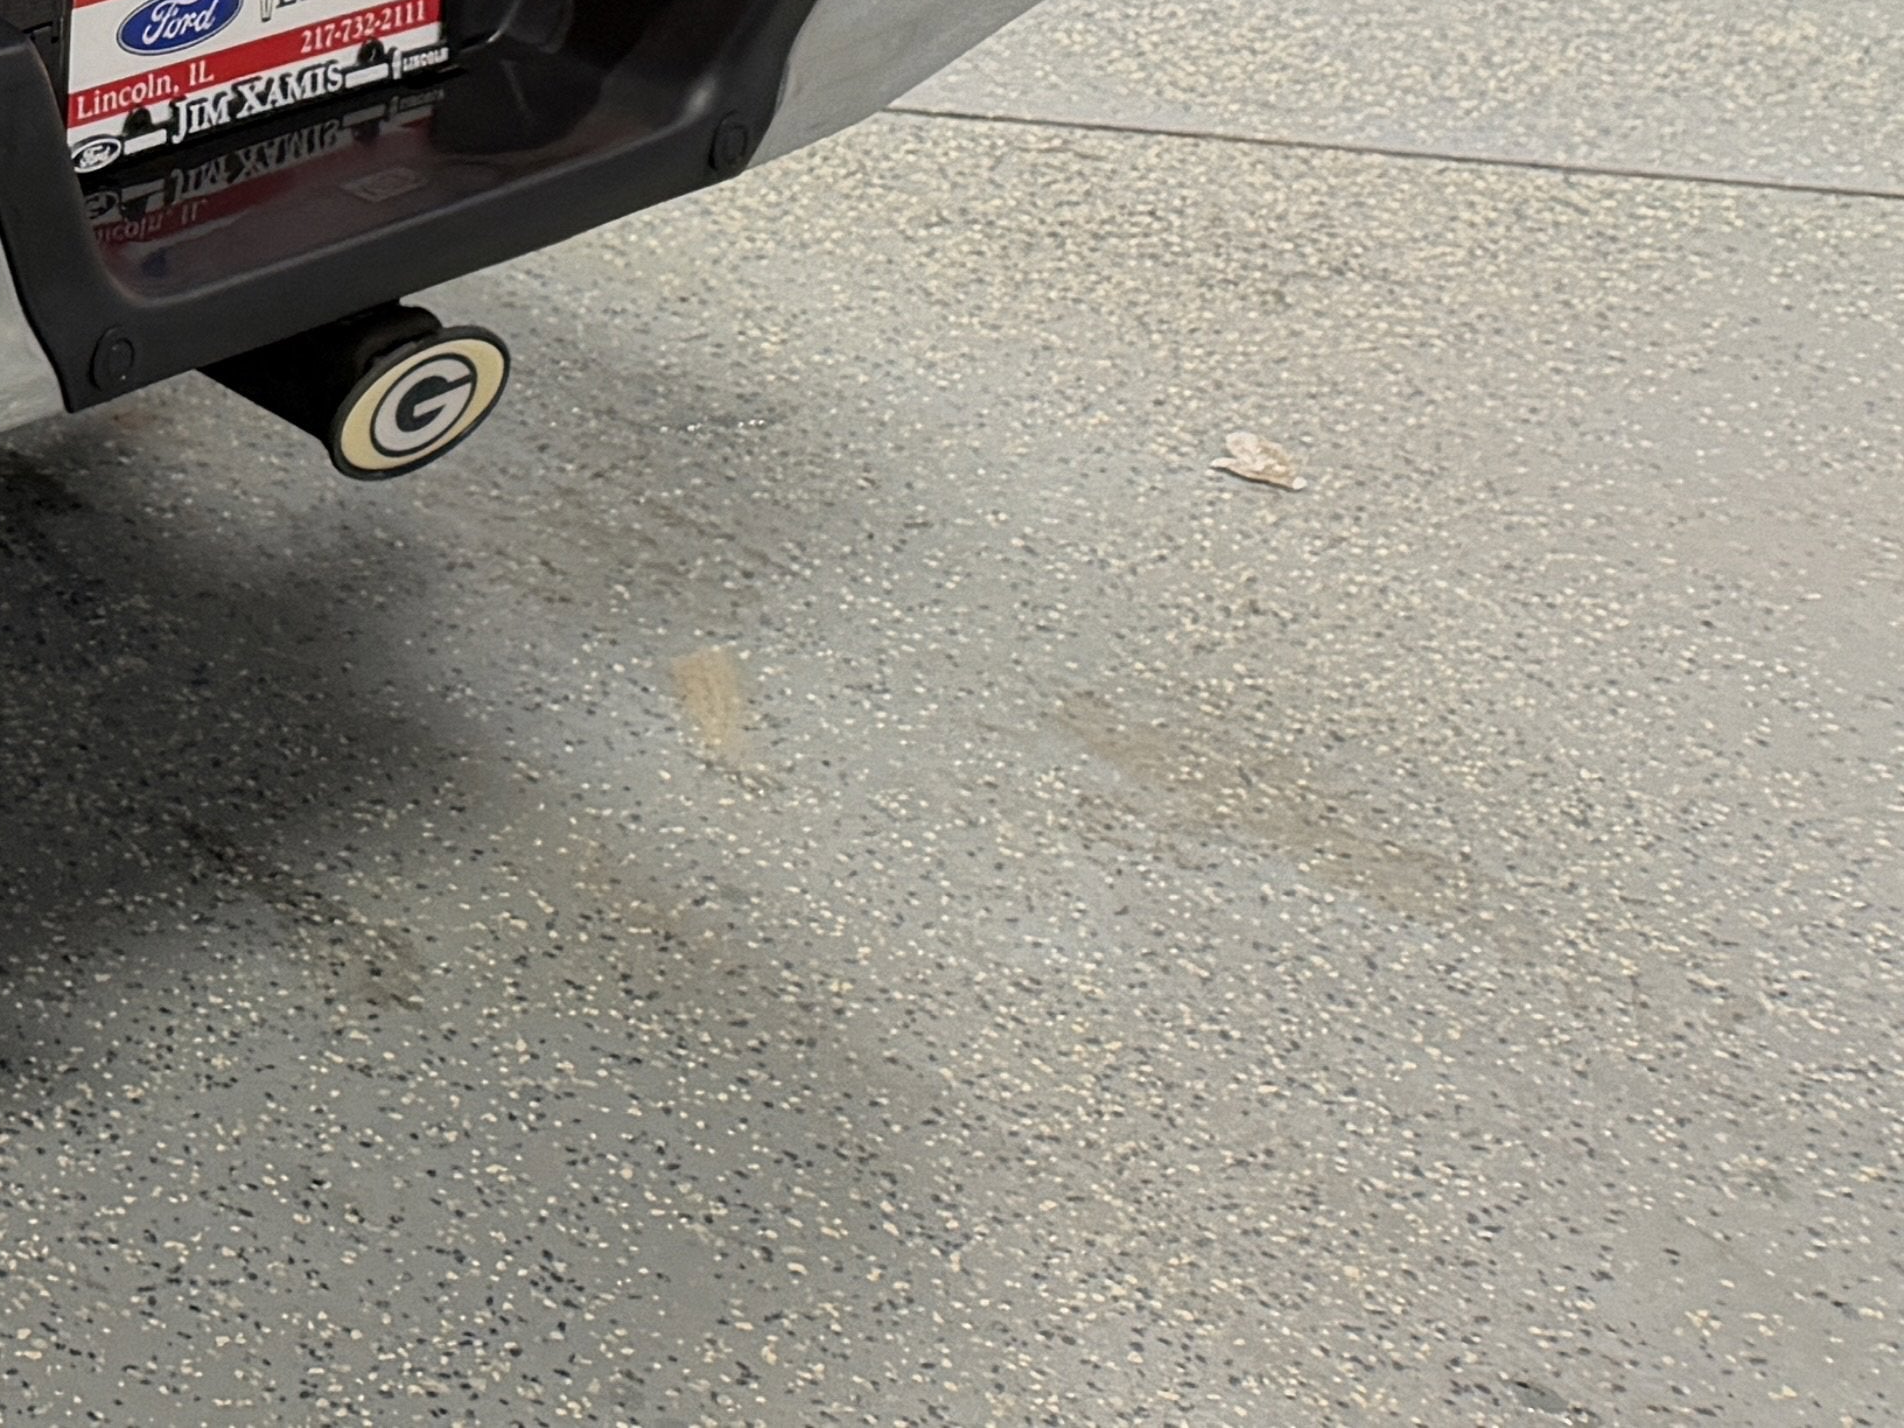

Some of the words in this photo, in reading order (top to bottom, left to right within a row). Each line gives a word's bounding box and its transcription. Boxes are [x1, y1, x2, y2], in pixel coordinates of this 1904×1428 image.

[76, 73, 180, 121] Lincoln,
[190, 61, 214, 97] IL
[171, 92, 230, 144] JIM
[238, 66, 344, 116] XAMIS
